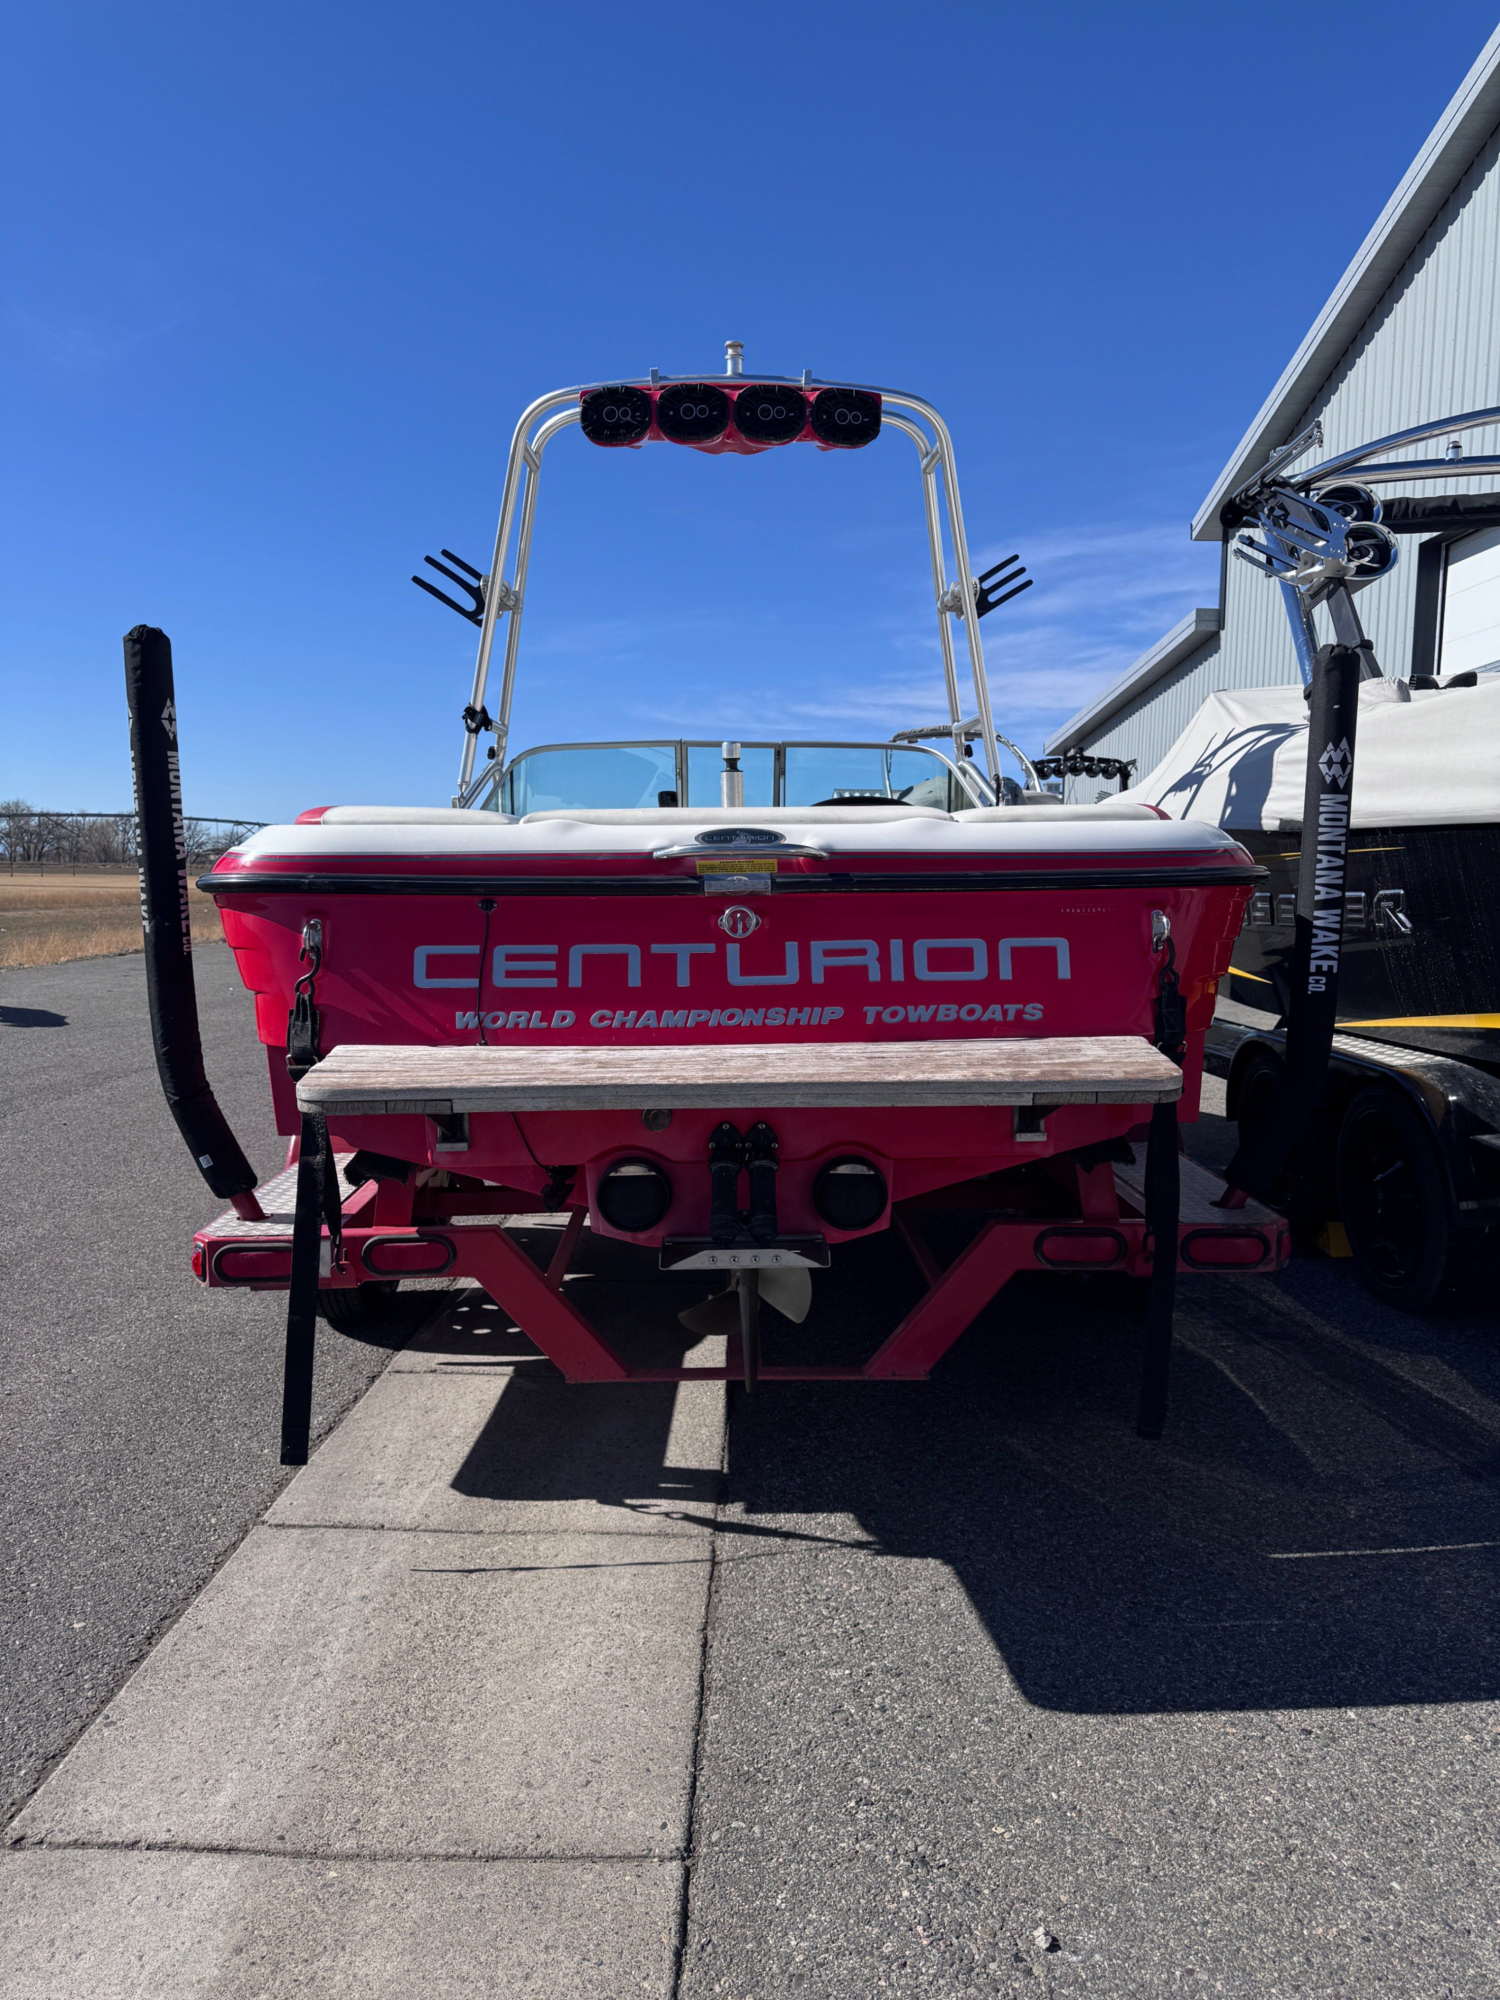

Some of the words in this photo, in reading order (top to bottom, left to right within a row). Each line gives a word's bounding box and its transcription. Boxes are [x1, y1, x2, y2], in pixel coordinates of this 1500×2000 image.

[1315, 794, 1348, 901] MONTANA
[413, 937, 1071, 989] CENTURION
[1310, 909, 1341, 973] WAKE
[1308, 976, 1327, 995] CO.
[455, 1010, 576, 1030] WORLD
[590, 1006, 845, 1029] CHAMPIONSHIP
[863, 1003, 1045, 1024] TOWBOATS
